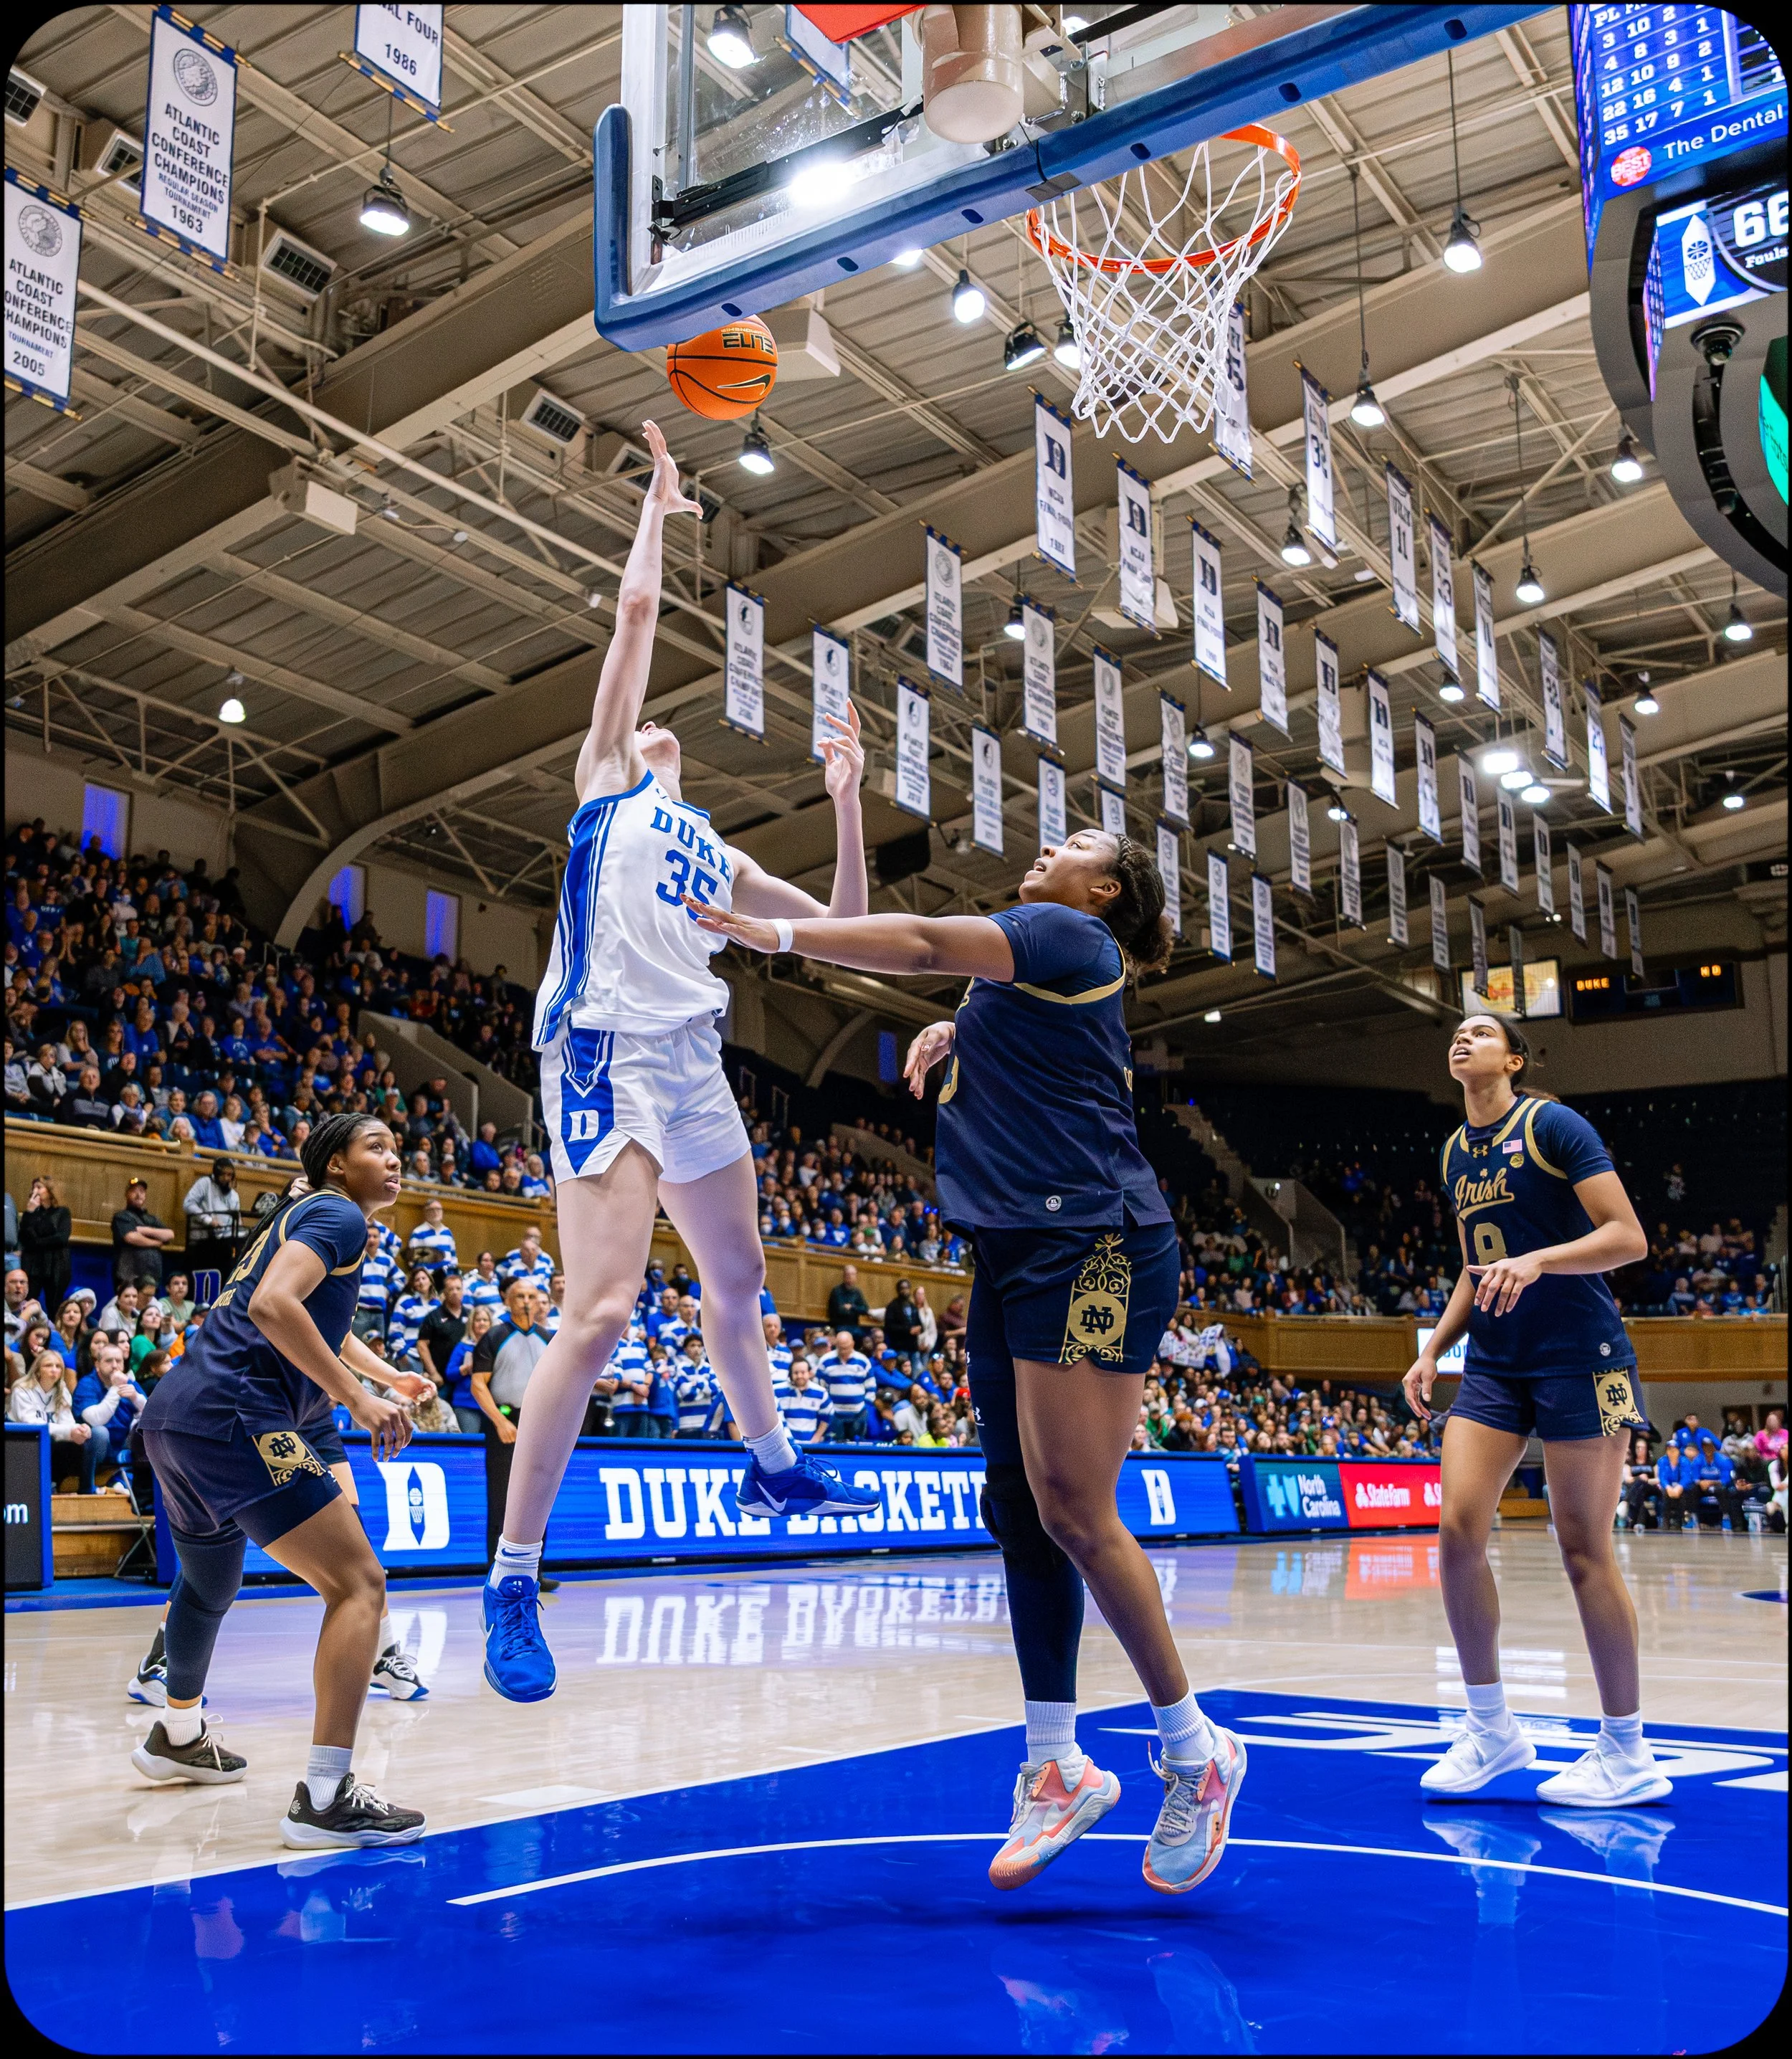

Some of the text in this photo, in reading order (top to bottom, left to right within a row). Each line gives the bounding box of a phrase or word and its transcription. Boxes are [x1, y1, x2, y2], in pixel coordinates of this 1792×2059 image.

[1603, 33, 1615, 48] 3
[1626, 16, 1651, 38] 10
[1663, 6, 1676, 22] 2
[1604, 17, 1709, 70] 4 8 3 1
[385, 43, 416, 75] 1986
[1601, 40, 1712, 98] 12 10 9 2
[1603, 65, 1714, 122] 22 16 4 1
[165, 103, 220, 146] ATLANTIC
[1604, 90, 1717, 146] 35 17 7 1
[1663, 103, 1784, 160] The Dental
[151, 132, 229, 189] CONFERENCE
[172, 126, 211, 158] COAST
[155, 153, 224, 204] CHAMPIONS
[172, 205, 204, 234] 1963
[9, 258, 64, 295] ATLANTIC
[16, 280, 54, 307] COAST
[4, 290, 72, 335] ONFERENCE
[4, 308, 67, 349] HAMPIONS
[12, 351, 45, 376] 2005
[721, 332, 775, 356] ELITE
[650, 805, 733, 882] DUKE
[655, 849, 719, 922] 35
[1576, 977, 1610, 992] DUKE
[1454, 1167, 1515, 1213] Irish
[1297, 1474, 1327, 1495] North
[4, 1503, 29, 1524] m
[1302, 1495, 1342, 1518] Carolina
